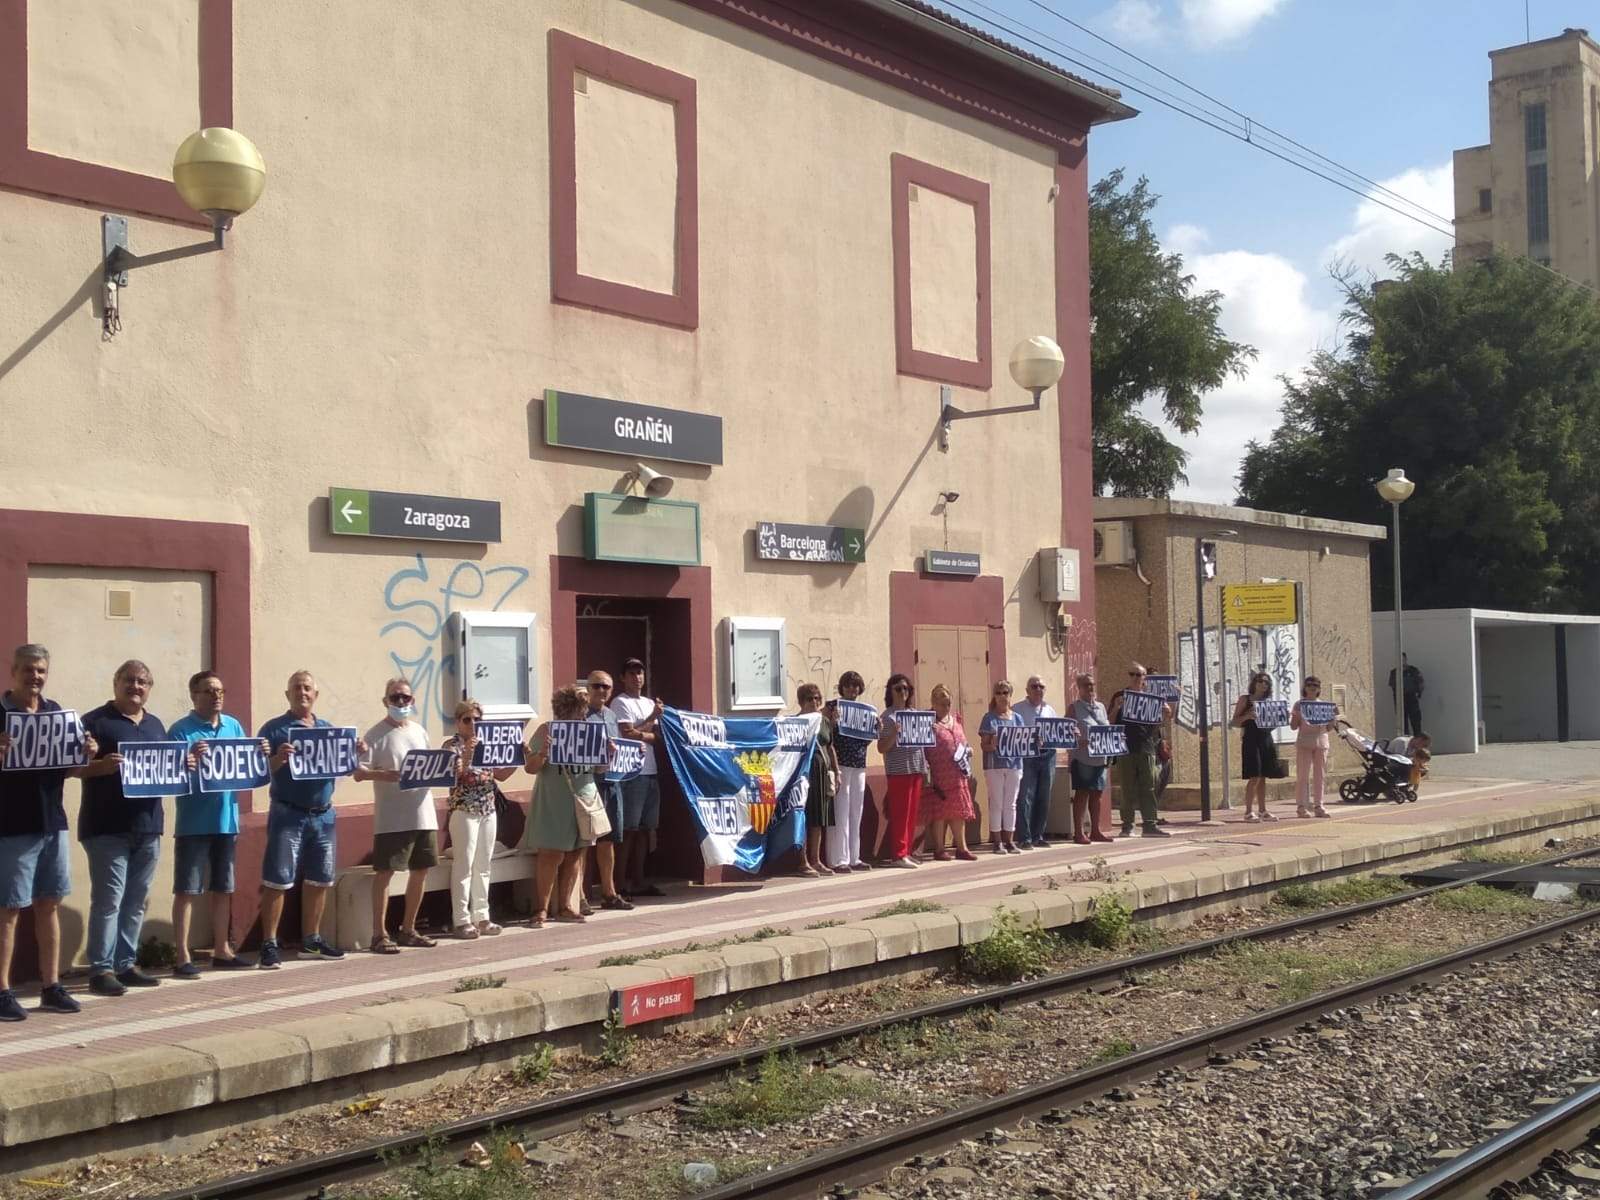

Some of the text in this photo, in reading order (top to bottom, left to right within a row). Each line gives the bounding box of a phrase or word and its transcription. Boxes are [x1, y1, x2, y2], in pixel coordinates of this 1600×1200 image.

[614, 415, 673, 444] GRAÑÉN
[404, 507, 471, 532] Zaragoza
[780, 534, 826, 550] Barcelona
[1123, 694, 1163, 722] VALFONDA
[1254, 701, 1288, 728] ROBRES
[7, 711, 86, 768] ROBRES
[477, 725, 523, 745] ALBERO
[550, 722, 608, 764] FRAELLA
[998, 727, 1036, 757] CURBE
[201, 745, 267, 780] SODETO
[292, 729, 358, 775] GRAÑÉN
[401, 752, 455, 781] FRULA
[482, 745, 514, 765] BAJO
[123, 749, 188, 785] ALBERUELA
[698, 800, 737, 834] TRENES
[645, 992, 682, 1009] No pasar
